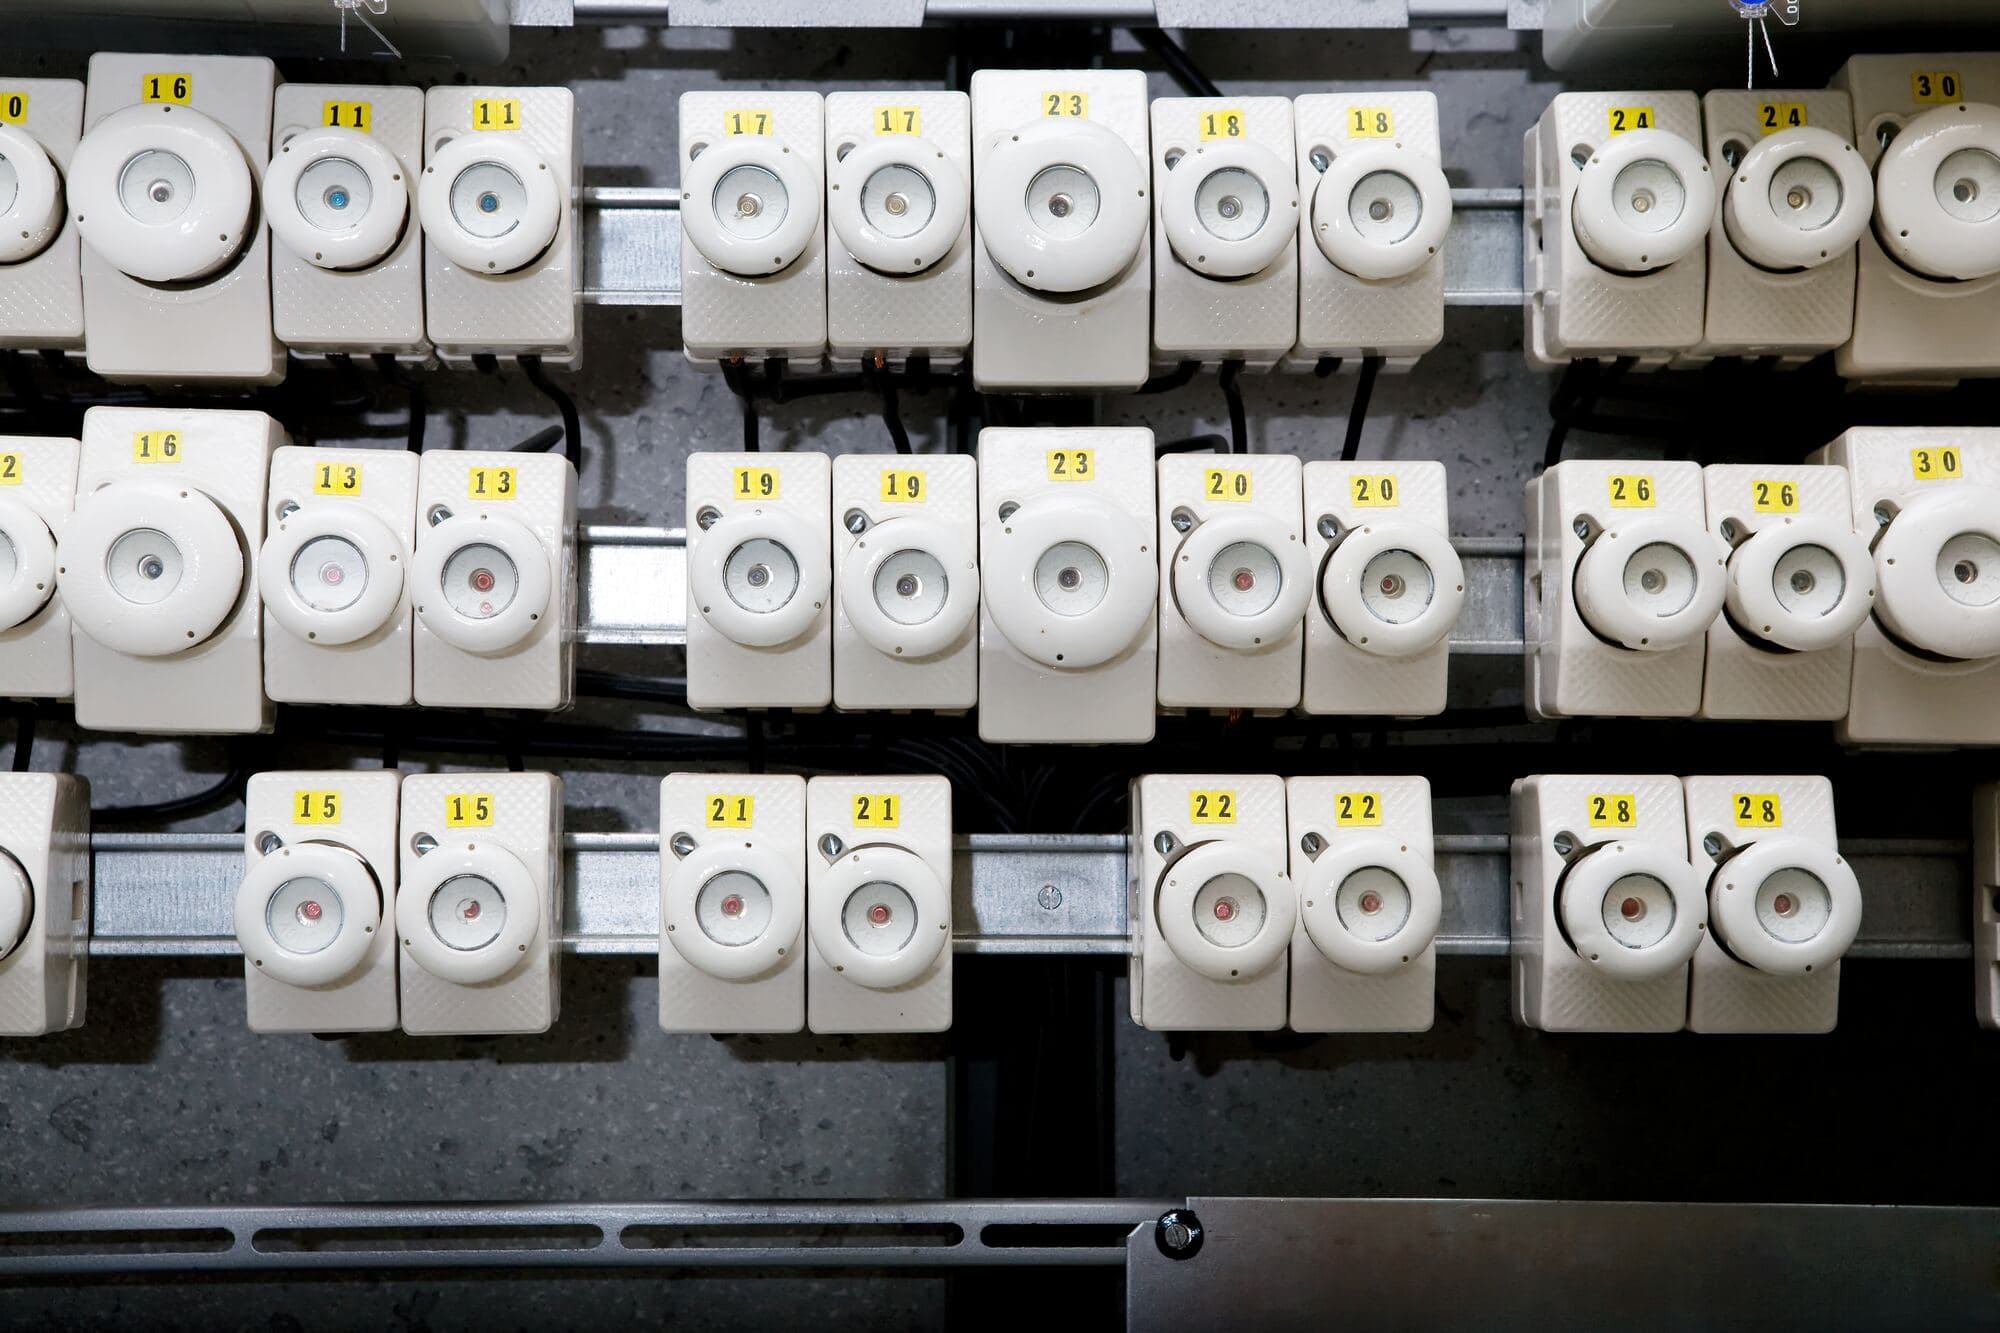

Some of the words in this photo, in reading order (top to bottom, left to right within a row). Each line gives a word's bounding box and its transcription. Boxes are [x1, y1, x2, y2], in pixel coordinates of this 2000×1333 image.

[151, 78, 186, 98] 16
[1917, 75, 1956, 98] 30
[329, 104, 364, 128] 11
[480, 102, 514, 125] 11
[1047, 94, 1082, 117] 23
[1763, 105, 1801, 128] 24
[732, 112, 767, 136] 17
[880, 109, 915, 133] 17
[1206, 114, 1240, 137] 18
[1354, 110, 1389, 134] 18
[1613, 110, 1650, 133] 24
[141, 434, 176, 457] 16
[1053, 452, 1088, 474] 23
[1917, 450, 1956, 473] 30
[321, 466, 356, 489] 13
[475, 471, 510, 494] 13
[740, 471, 773, 496] 19
[887, 474, 920, 498] 19
[1211, 472, 1247, 495] 20
[1356, 478, 1393, 501] 20
[1612, 477, 1650, 501] 26
[1756, 483, 1794, 507] 26
[300, 794, 336, 818] 15
[453, 797, 488, 821] 15
[712, 798, 747, 822] 21
[857, 796, 893, 821] 21
[1196, 794, 1231, 818] 22
[1339, 795, 1376, 819] 22
[1593, 796, 1630, 823] 28
[1738, 796, 1776, 823] 28
